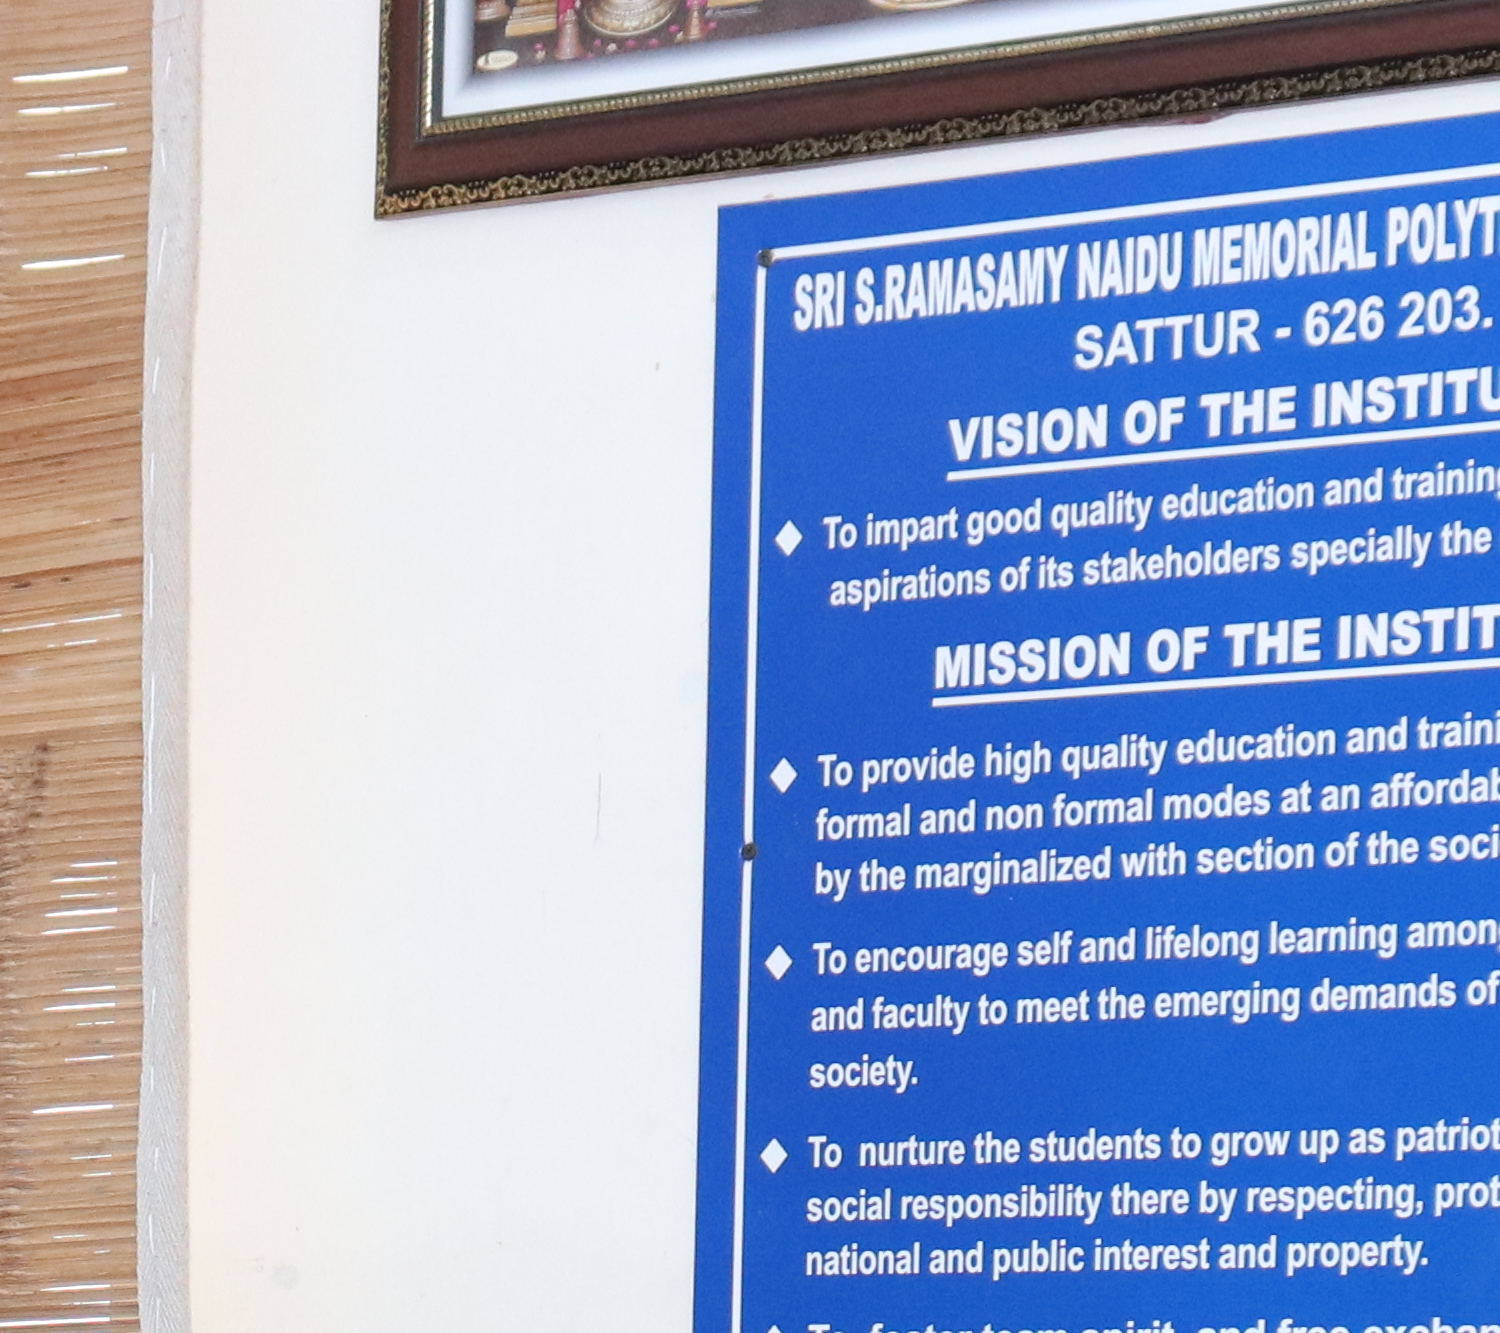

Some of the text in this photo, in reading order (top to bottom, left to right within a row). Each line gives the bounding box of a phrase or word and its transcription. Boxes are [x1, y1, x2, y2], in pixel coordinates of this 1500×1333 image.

[792, 269, 846, 332] SRI
[853, 243, 1070, 325] S.RAMASAMY
[1075, 230, 1183, 301] NAIDU
[1191, 209, 1377, 288] MEMORIAL
[1073, 283, 1493, 371] SATTUR - 626 203.
[947, 403, 1108, 462] VISION
[1121, 395, 1186, 446] OF
[1198, 384, 1297, 438] THE
[821, 514, 858, 550] To
[865, 505, 959, 552] impart
[965, 496, 1042, 547] good
[1049, 489, 1154, 538] quality
[1159, 475, 1315, 521] education
[1322, 466, 1383, 507] and
[828, 563, 991, 612] aspirations
[998, 555, 1032, 593] of
[1037, 554, 1074, 590] its
[1081, 538, 1281, 586] stakeholders
[1289, 523, 1433, 576] specially
[1438, 519, 1493, 557] the
[933, 630, 1131, 690] MISSION
[1145, 625, 1210, 674] OF
[1221, 616, 1322, 668] THE
[816, 752, 853, 787] To
[860, 744, 976, 793] provide
[983, 739, 1052, 784] high
[1059, 732, 1168, 780] quality
[1174, 722, 1336, 765] education
[1344, 714, 1408, 755] and
[814, 860, 851, 902] by
[857, 858, 906, 893] the
[914, 844, 1112, 895] marginalized
[1119, 840, 1187, 878] with
[1195, 835, 1315, 875] section
[1323, 830, 1360, 868] of
[1365, 829, 1420, 866] the
